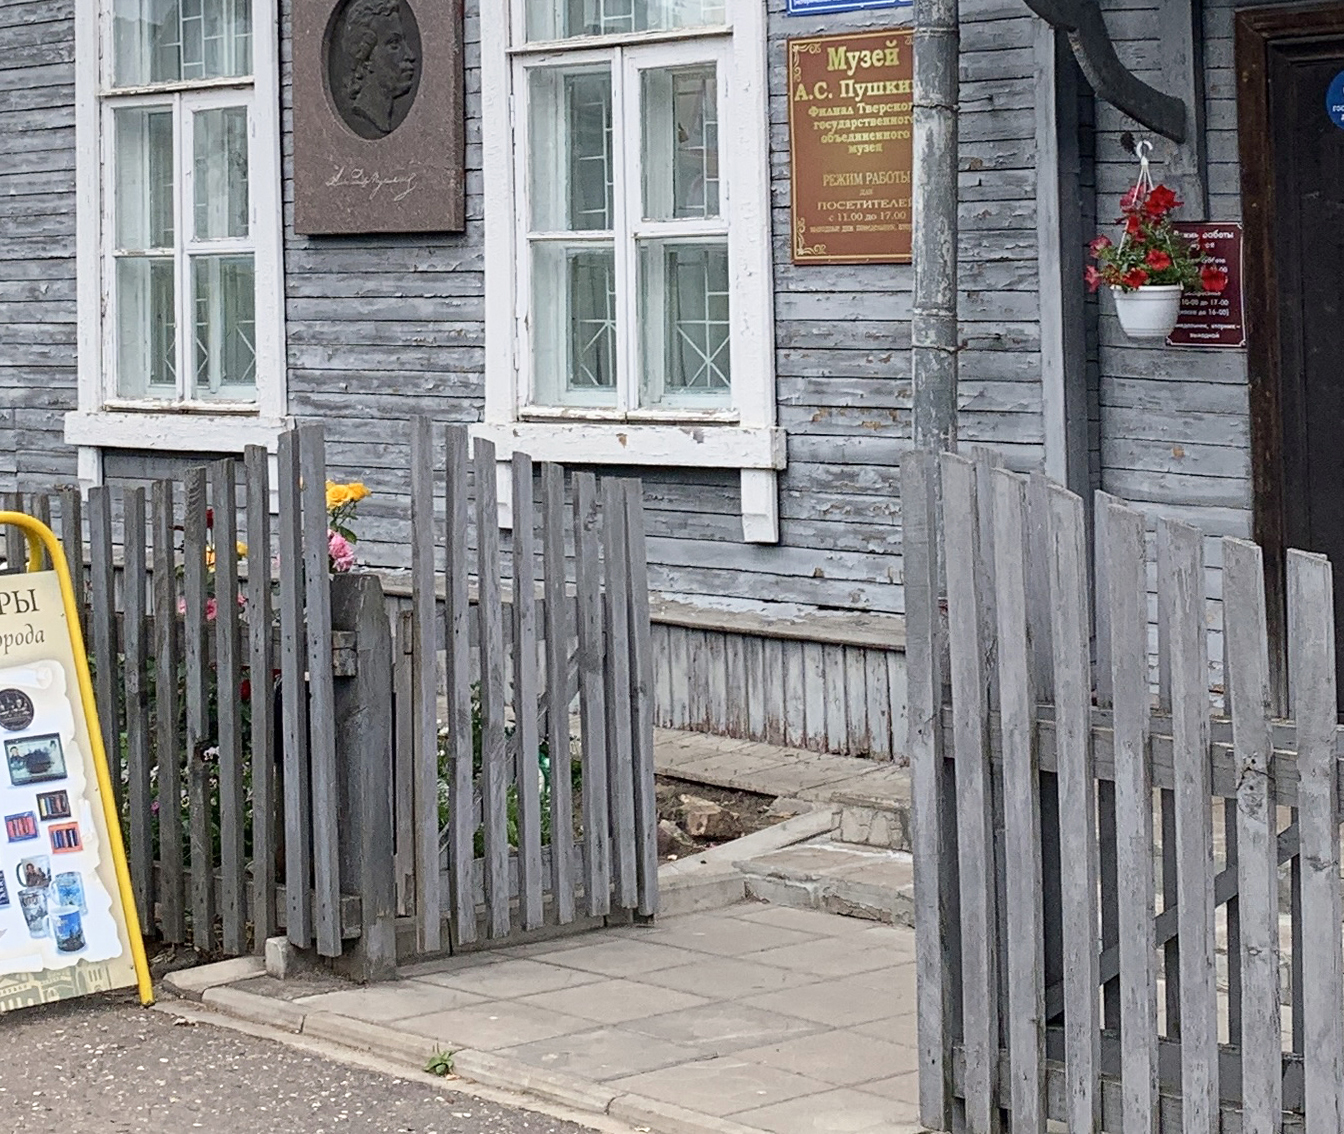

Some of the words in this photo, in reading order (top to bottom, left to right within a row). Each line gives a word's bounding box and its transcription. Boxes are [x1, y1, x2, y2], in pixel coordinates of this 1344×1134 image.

[826, 39, 900, 76] Музей
[839, 79, 913, 102] Пушки
[808, 106, 854, 117] Филиал
[820, 130, 910, 143] объединенного
[823, 172, 863, 186] РЕЖИМ
[866, 170, 911, 185] РАБОТЫ
[837, 212, 863, 222] 11.00
[864, 213, 877, 222] до
[880, 211, 907, 221] 17.00
